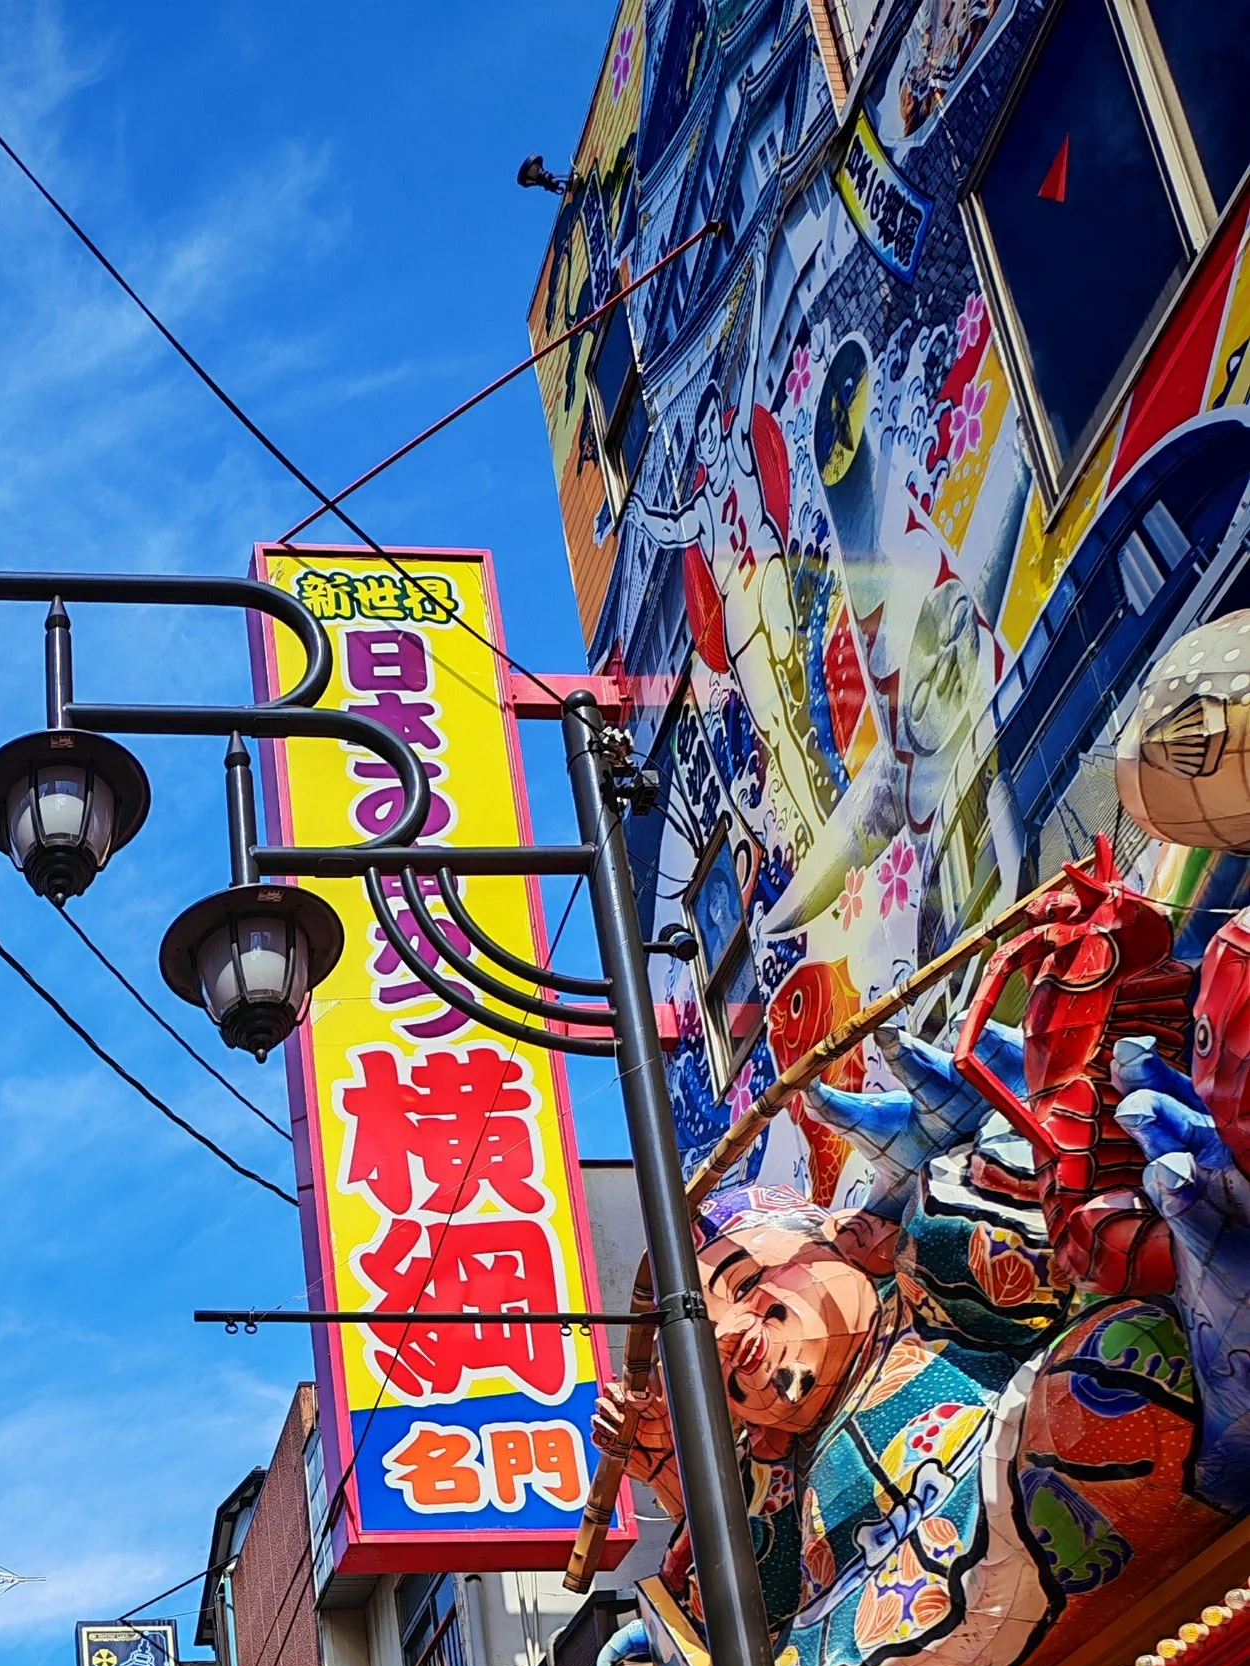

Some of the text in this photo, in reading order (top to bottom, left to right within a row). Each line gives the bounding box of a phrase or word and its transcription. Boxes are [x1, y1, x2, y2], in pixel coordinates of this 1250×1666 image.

[298, 573, 458, 623] 新世界
[342, 1047, 566, 1396] 横綱
[391, 1427, 582, 1505] 名門
